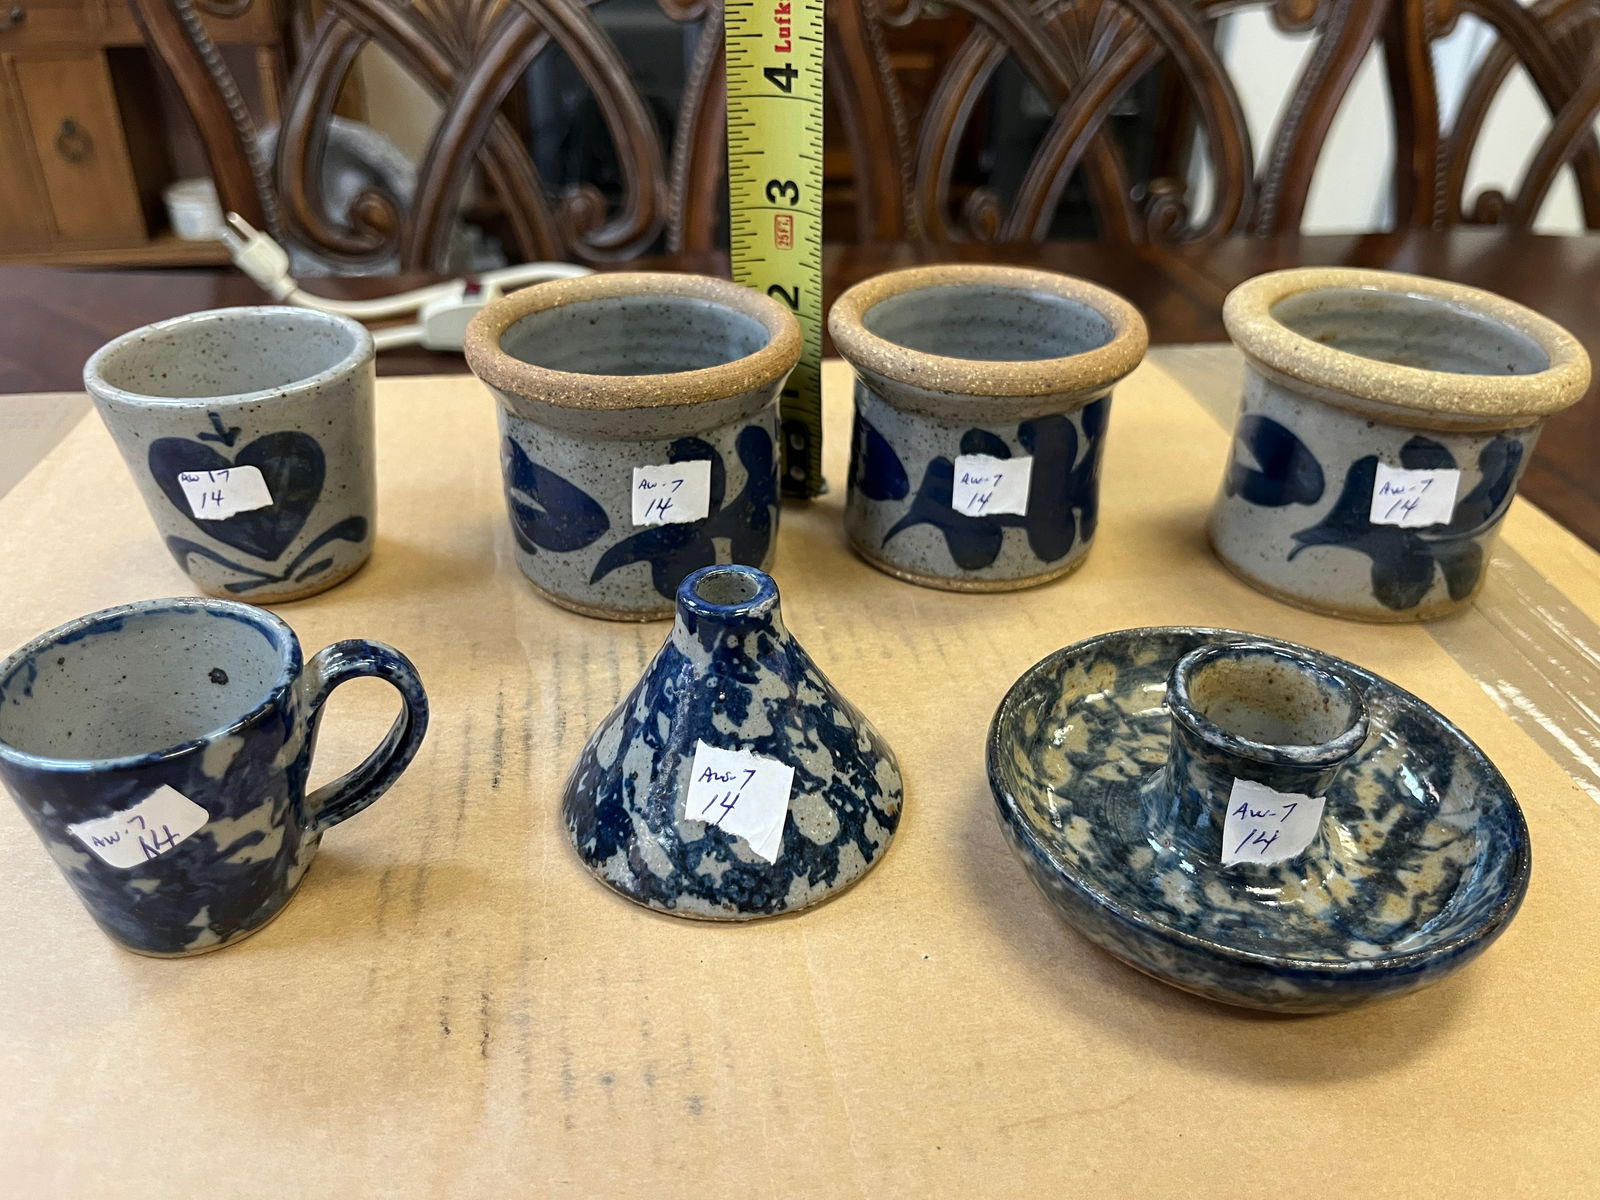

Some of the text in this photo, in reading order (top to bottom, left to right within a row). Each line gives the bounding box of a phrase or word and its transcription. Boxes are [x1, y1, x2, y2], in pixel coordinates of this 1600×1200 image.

[763, 63, 798, 93] 4
[766, 179, 799, 206] 3
[767, 284, 799, 310] 2
[202, 489, 225, 509] 14
[644, 497, 674, 520] 14
[967, 491, 993, 513] 14
[1384, 497, 1420, 521] 14
[701, 791, 741, 825] 14
[1234, 828, 1280, 855] 14
